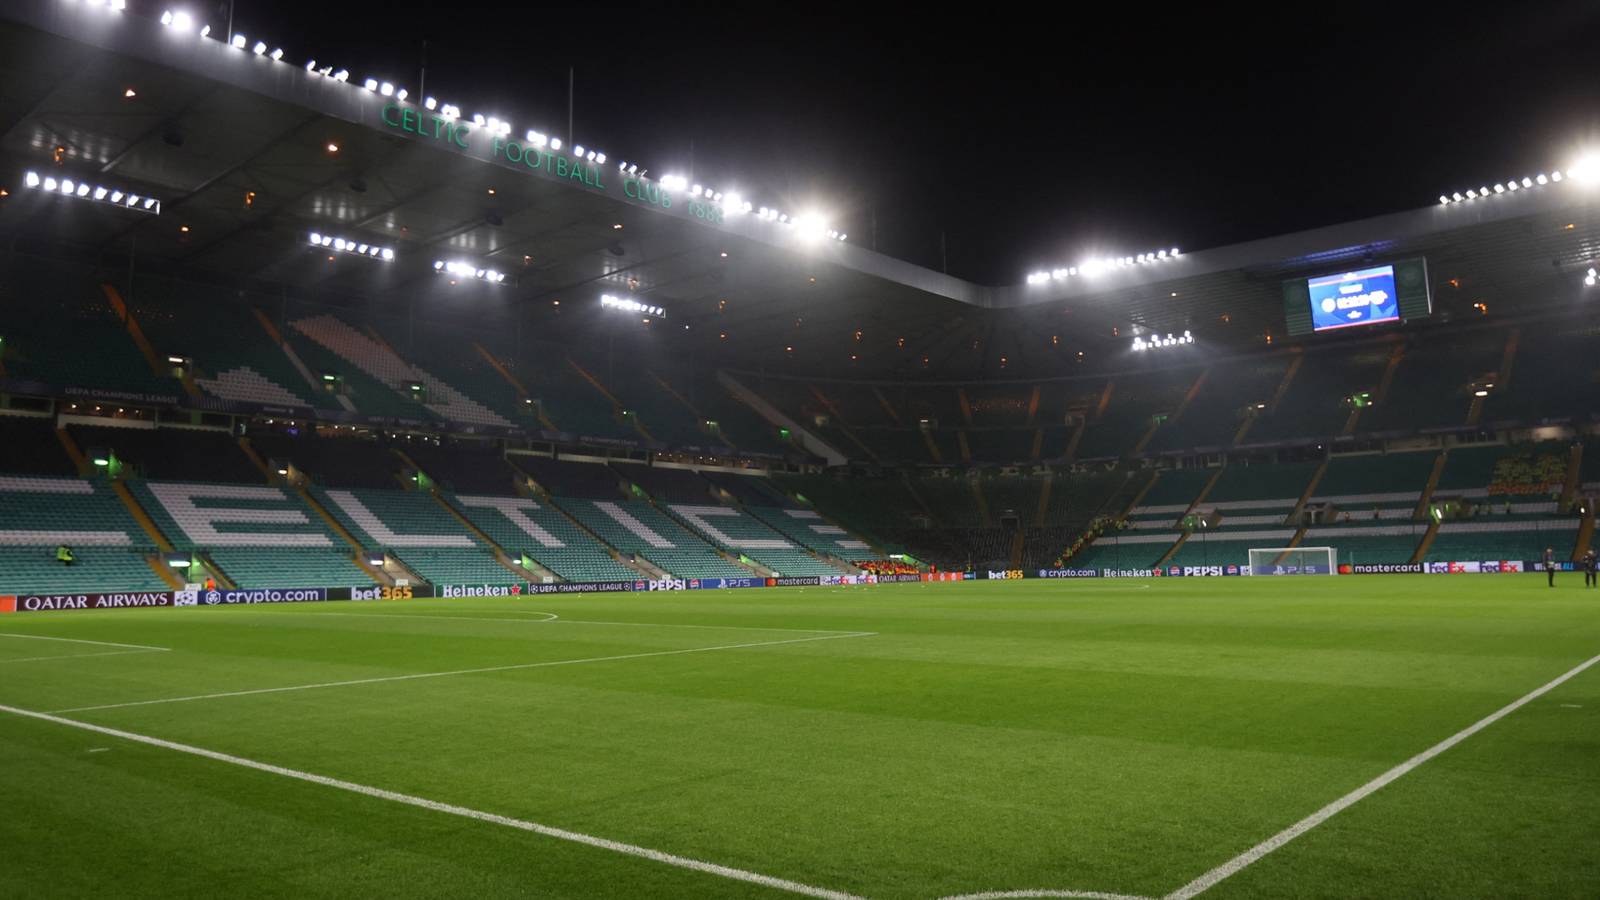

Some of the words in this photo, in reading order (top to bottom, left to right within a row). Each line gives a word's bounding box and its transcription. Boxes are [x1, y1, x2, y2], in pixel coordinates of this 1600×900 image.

[382, 102, 470, 149] CELTIC
[493, 136, 605, 189] FOOTBALL
[623, 177, 672, 209] CLUB
[687, 197, 726, 225] 1888
[65, 387, 89, 395] UEFA
[1104, 567, 1152, 577] Heineken
[1184, 565, 1223, 576] PEPSI
[1355, 563, 1421, 573] mastercard
[1429, 562, 1465, 574] FedEx
[1480, 561, 1518, 573] FedEx
[989, 570, 1024, 579] bet365
[1048, 569, 1096, 578] crypto.com
[649, 578, 687, 592] PEPSI
[728, 579, 750, 587] PS5
[777, 577, 819, 587] mastercard
[351, 585, 413, 600] bet365
[442, 583, 510, 598] Heineken
[539, 585, 558, 593] UEFA
[558, 584, 597, 593] CHAMPIONS
[598, 583, 623, 591] LEAGUE
[25, 595, 88, 611] QATAR
[95, 592, 168, 608] AIRWAYS
[226, 588, 319, 604] crypto.com
